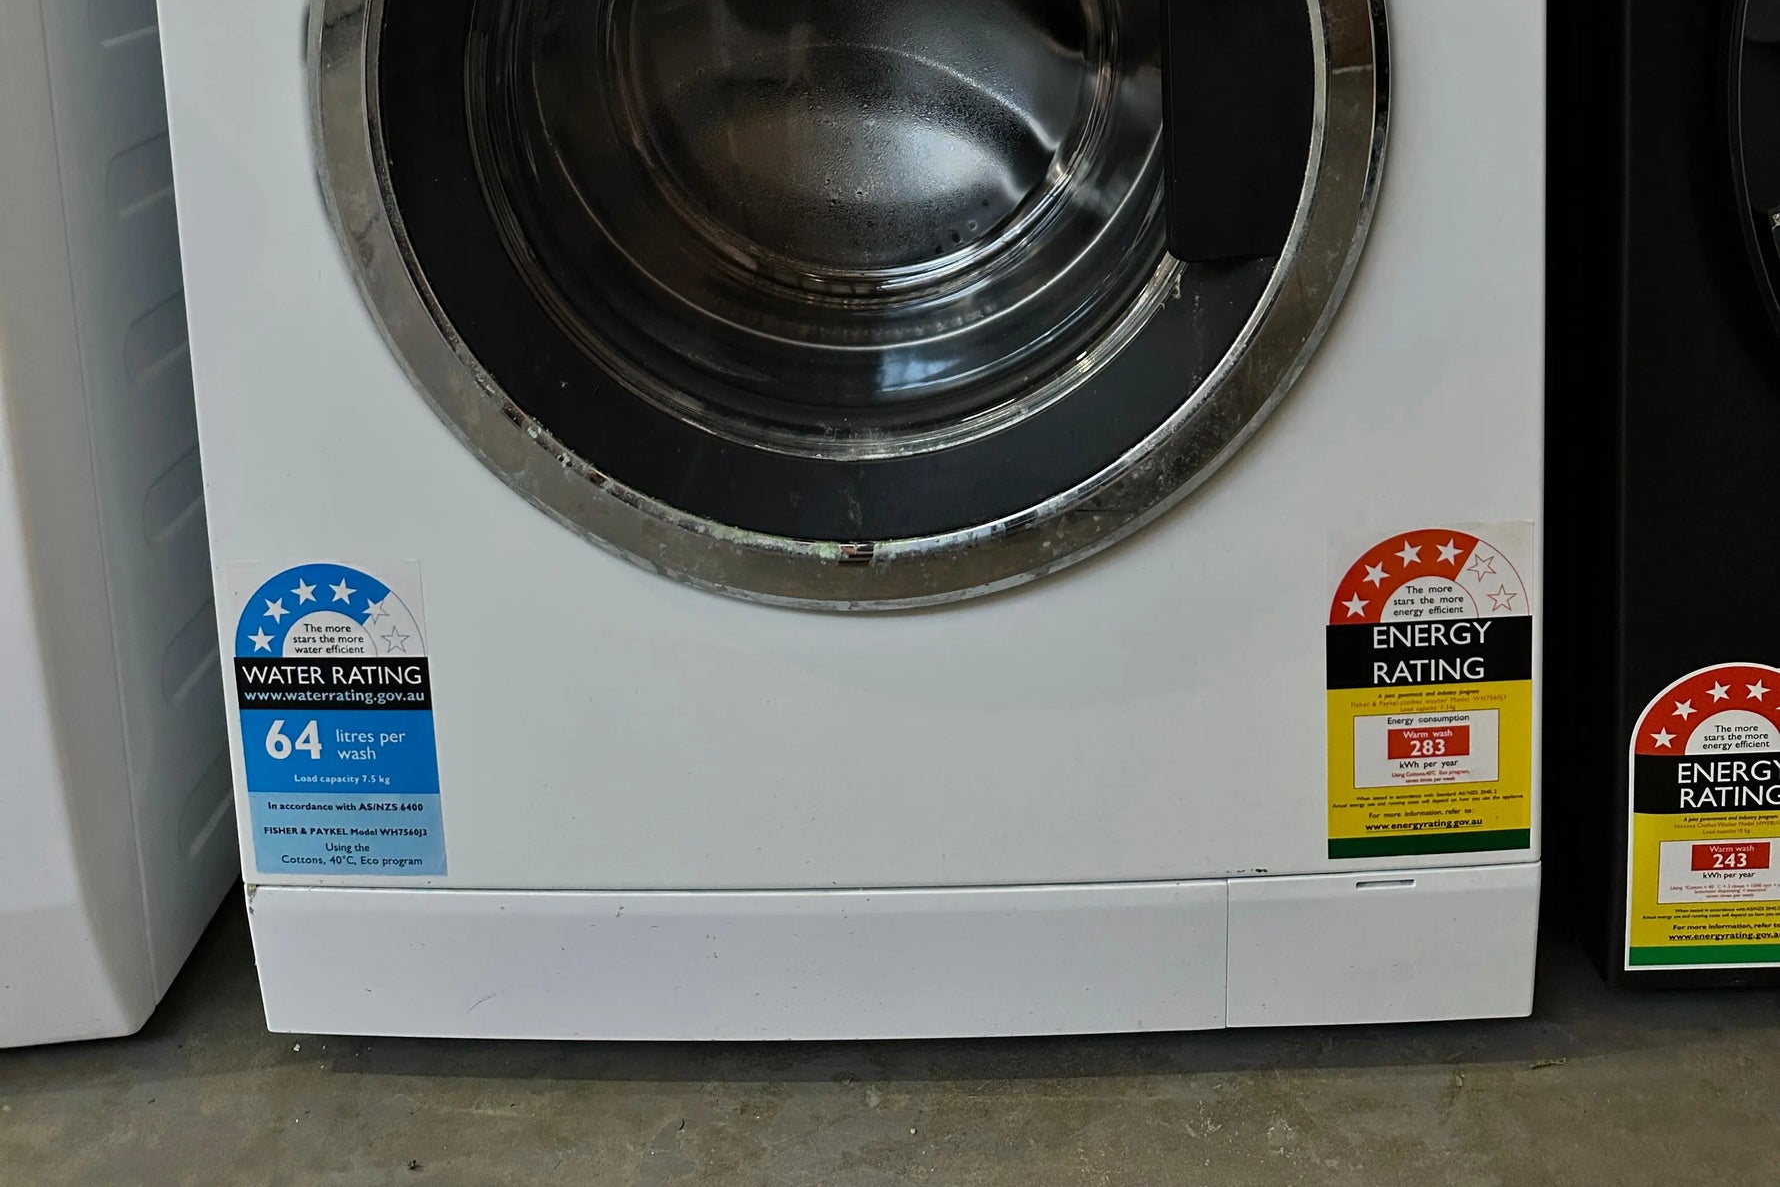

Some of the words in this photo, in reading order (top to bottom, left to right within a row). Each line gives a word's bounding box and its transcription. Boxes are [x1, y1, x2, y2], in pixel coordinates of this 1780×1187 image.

[1406, 586, 1423, 594] The
[1429, 585, 1453, 593] more
[1393, 597, 1414, 605] stars
[1420, 596, 1435, 604] the
[1440, 595, 1463, 603] more
[1393, 608, 1424, 617] energy
[1429, 606, 1463, 614] efficient
[303, 624, 322, 632] The
[293, 635, 317, 643] stars
[319, 635, 335, 643] the
[1373, 621, 1492, 649] ENERGY
[326, 645, 364, 653] efficient
[242, 666, 325, 684] WATER
[332, 666, 422, 684] RATING
[1373, 657, 1485, 684] RATING
[244, 689, 424, 704] www.waterrating.gov.au
[1387, 717, 1414, 725] Energy
[1419, 714, 1469, 724] consumption
[1403, 731, 1428, 739] Warm
[1433, 729, 1453, 737] wash
[265, 720, 322, 760] 64
[336, 729, 374, 743] litres
[380, 732, 405, 746] per
[1410, 739, 1445, 756] 283
[1703, 742, 1732, 750] energy
[337, 747, 376, 760] wash
[1399, 761, 1419, 769] kWh
[1424, 761, 1438, 769] per
[1441, 759, 1458, 768] year
[320, 775, 359, 784] capacity
[362, 775, 376, 783] 7.5
[379, 775, 390, 784] kg
[1680, 785, 1780, 808] RATING
[279, 803, 333, 811] accordance
[336, 803, 356, 811] with
[359, 803, 397, 811] AS/NZS
[401, 803, 423, 811] 6400
[1445, 808, 1461, 816] refer
[1365, 818, 1483, 831] www.energyrating.gov.au
[264, 827, 298, 835] FISHER
[351, 828, 378, 836] Model
[325, 843, 352, 853] Using
[282, 855, 326, 865] Cottons,
[361, 856, 379, 865] Eco
[382, 857, 423, 867] program
[1713, 854, 1747, 868] 243
